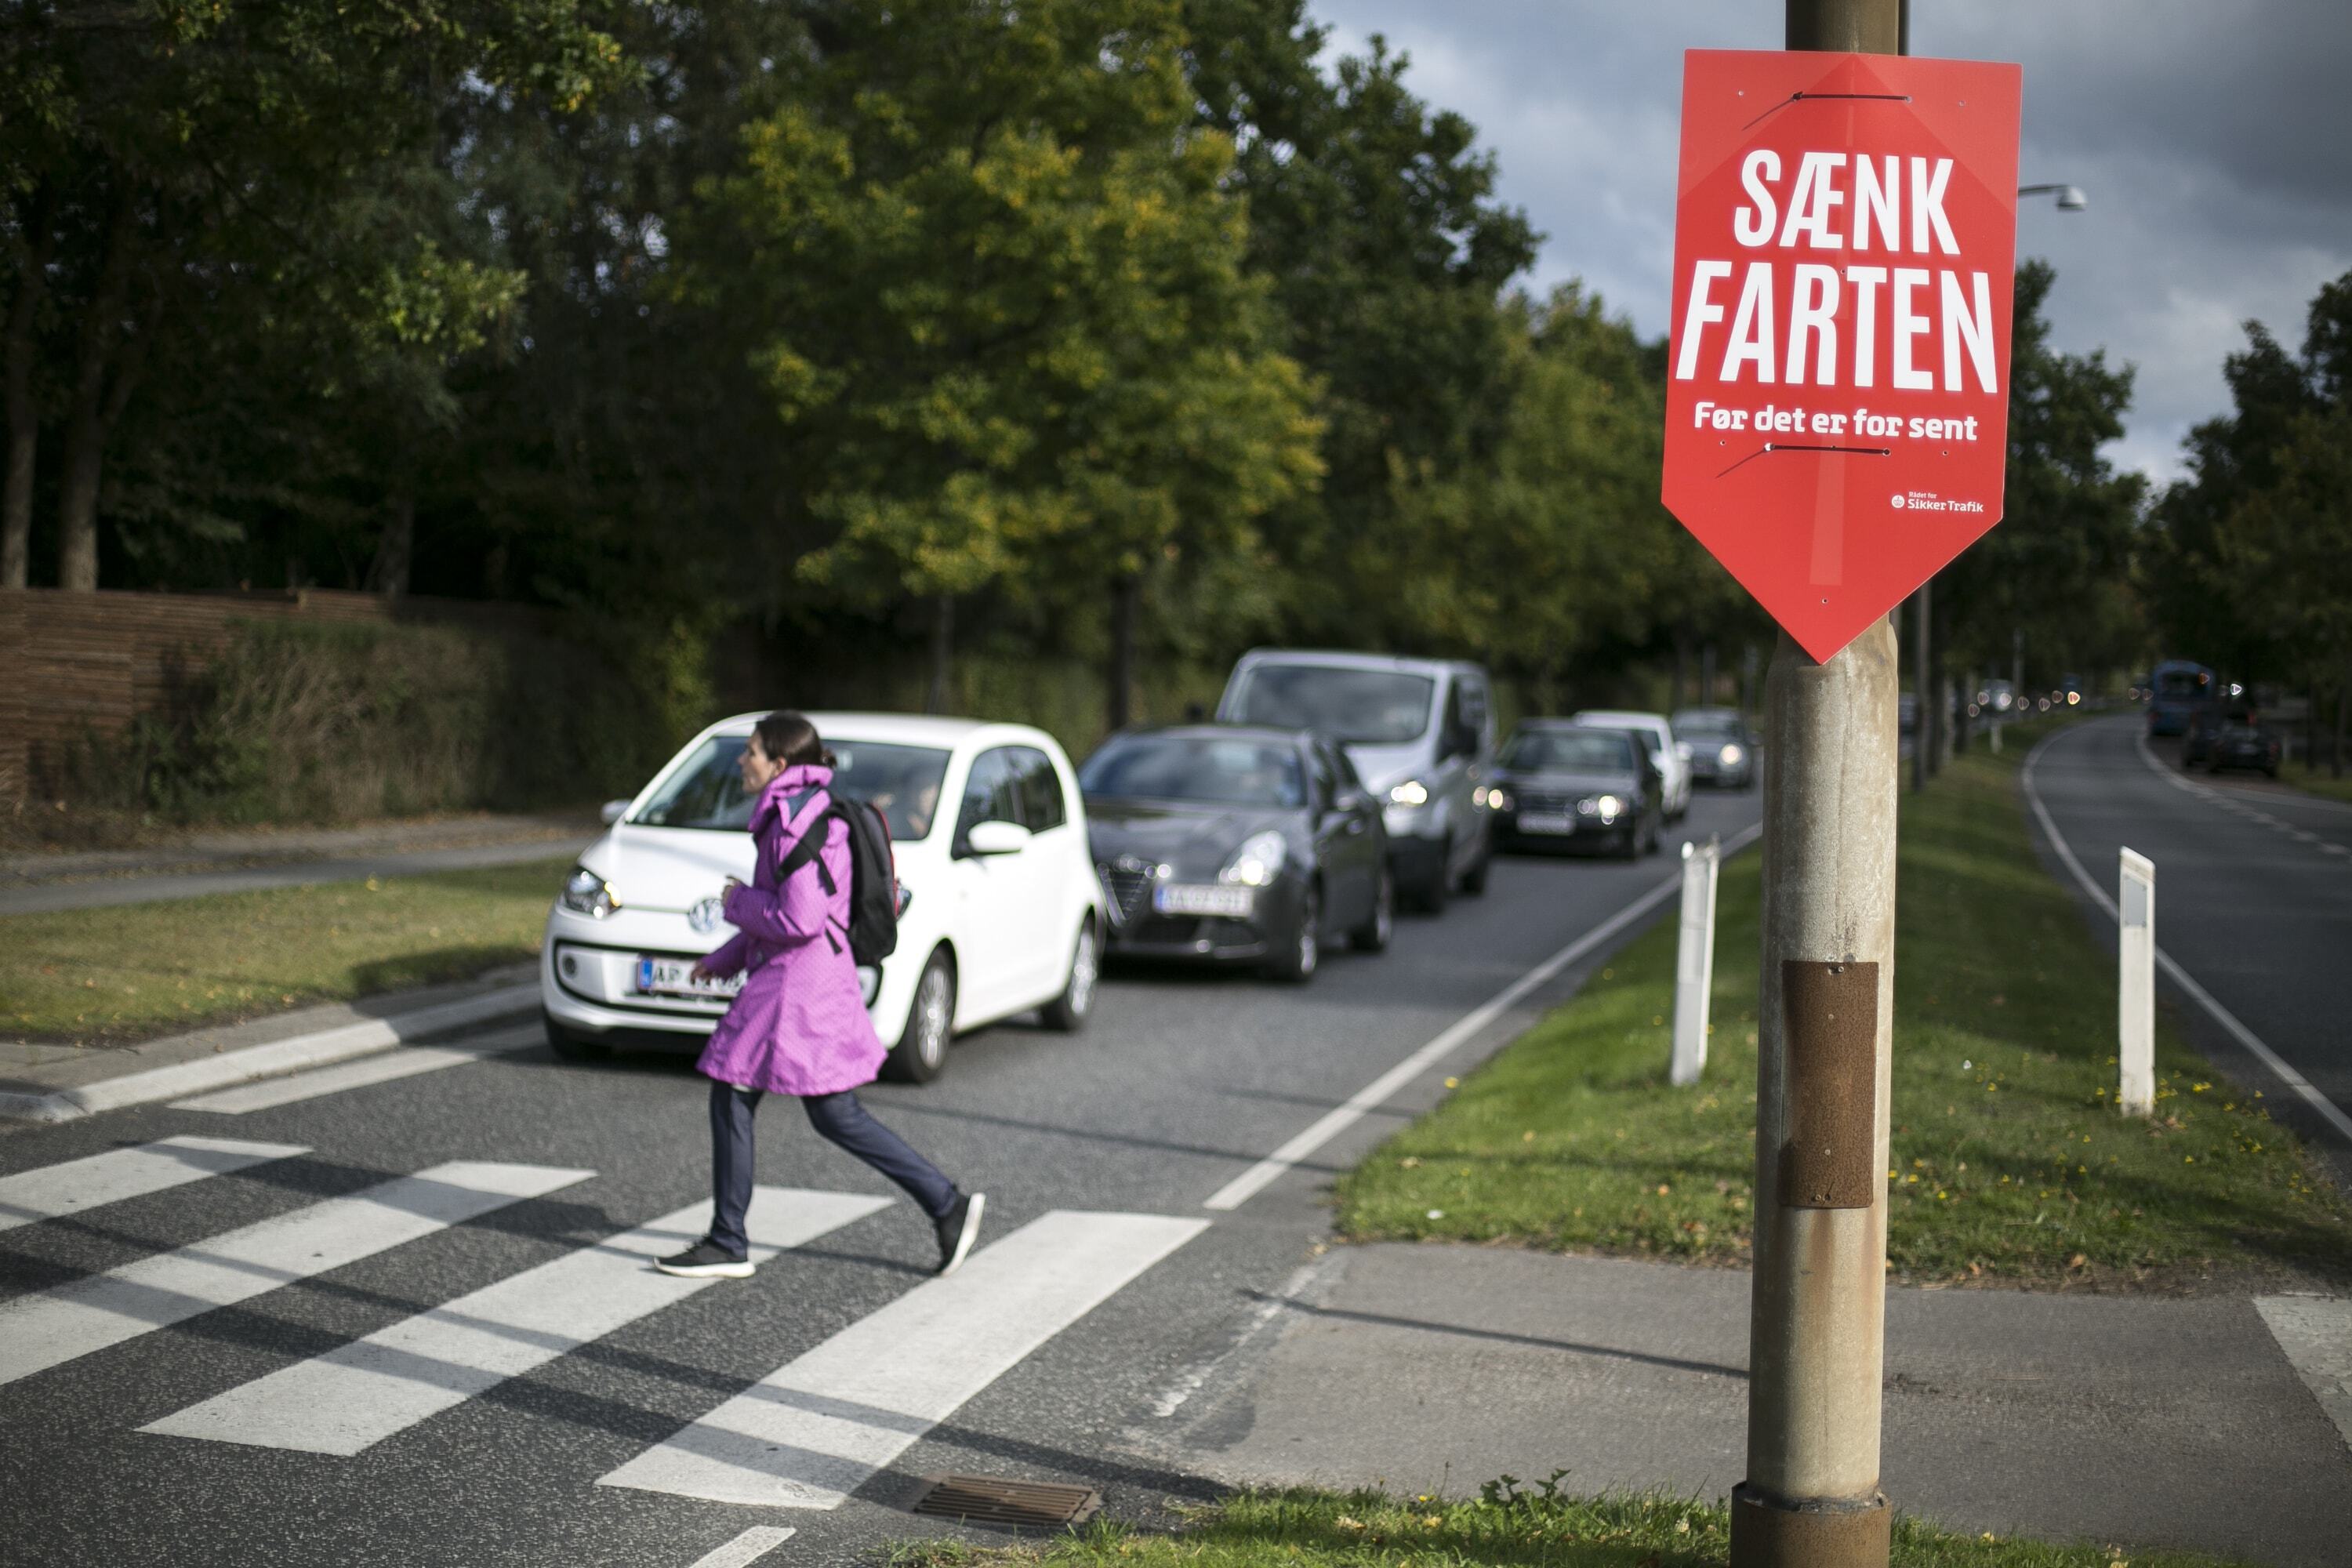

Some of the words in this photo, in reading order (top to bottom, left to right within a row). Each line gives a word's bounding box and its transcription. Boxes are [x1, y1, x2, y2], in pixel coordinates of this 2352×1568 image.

[1733, 149, 1962, 256] SÆNK
[1675, 260, 1998, 394] FARTEN
[1693, 401, 1748, 430] Før
[1754, 404, 1806, 433] det
[1811, 412, 1848, 434] er
[1853, 408, 1904, 437] for
[1908, 416, 1978, 441] sent
[1907, 499, 1947, 511] Sikker
[1947, 500, 1984, 513] Trafik
